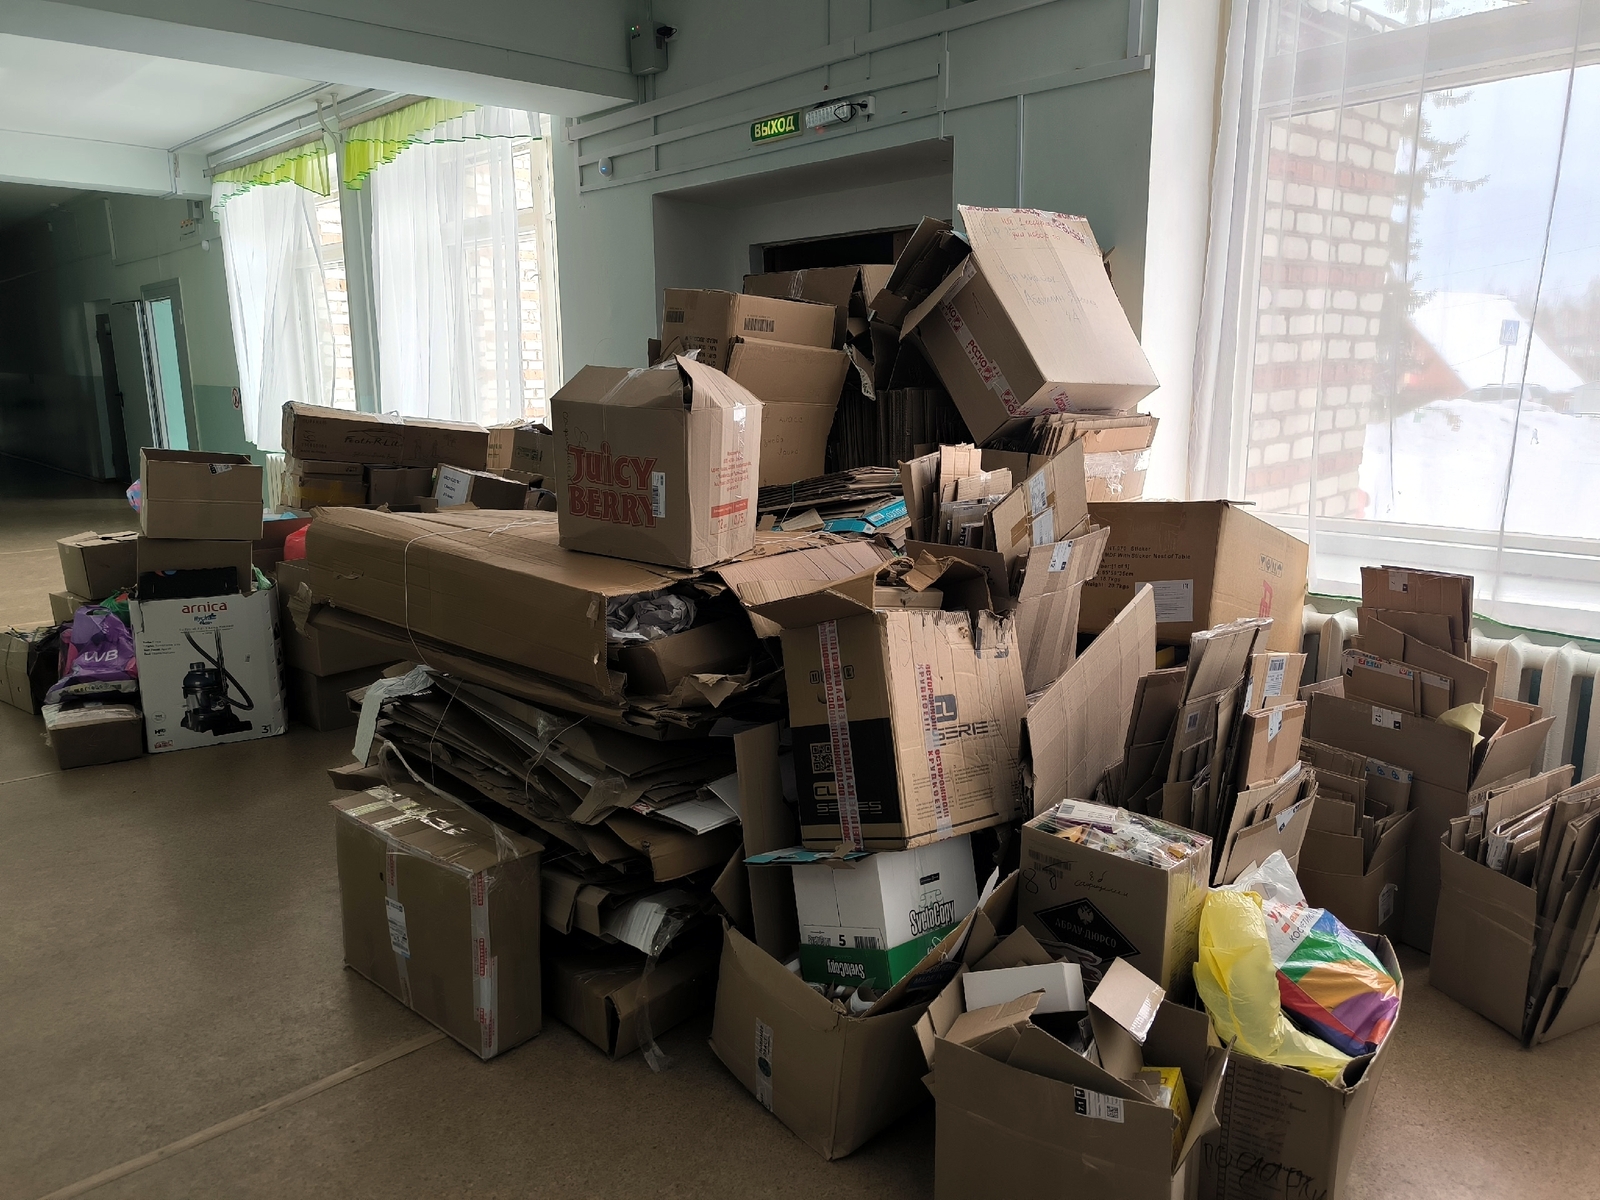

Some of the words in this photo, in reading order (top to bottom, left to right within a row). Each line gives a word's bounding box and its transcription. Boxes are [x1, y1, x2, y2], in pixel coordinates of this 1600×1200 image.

[754, 115, 795, 138] ВЫХОД
[567, 483, 657, 529] BERRY
[181, 601, 228, 614] arnica
[816, 800, 883, 816] SEES
[909, 900, 955, 936] SvetoCopy
[838, 934, 846, 947] 5
[826, 958, 866, 980] SvetoCopy
